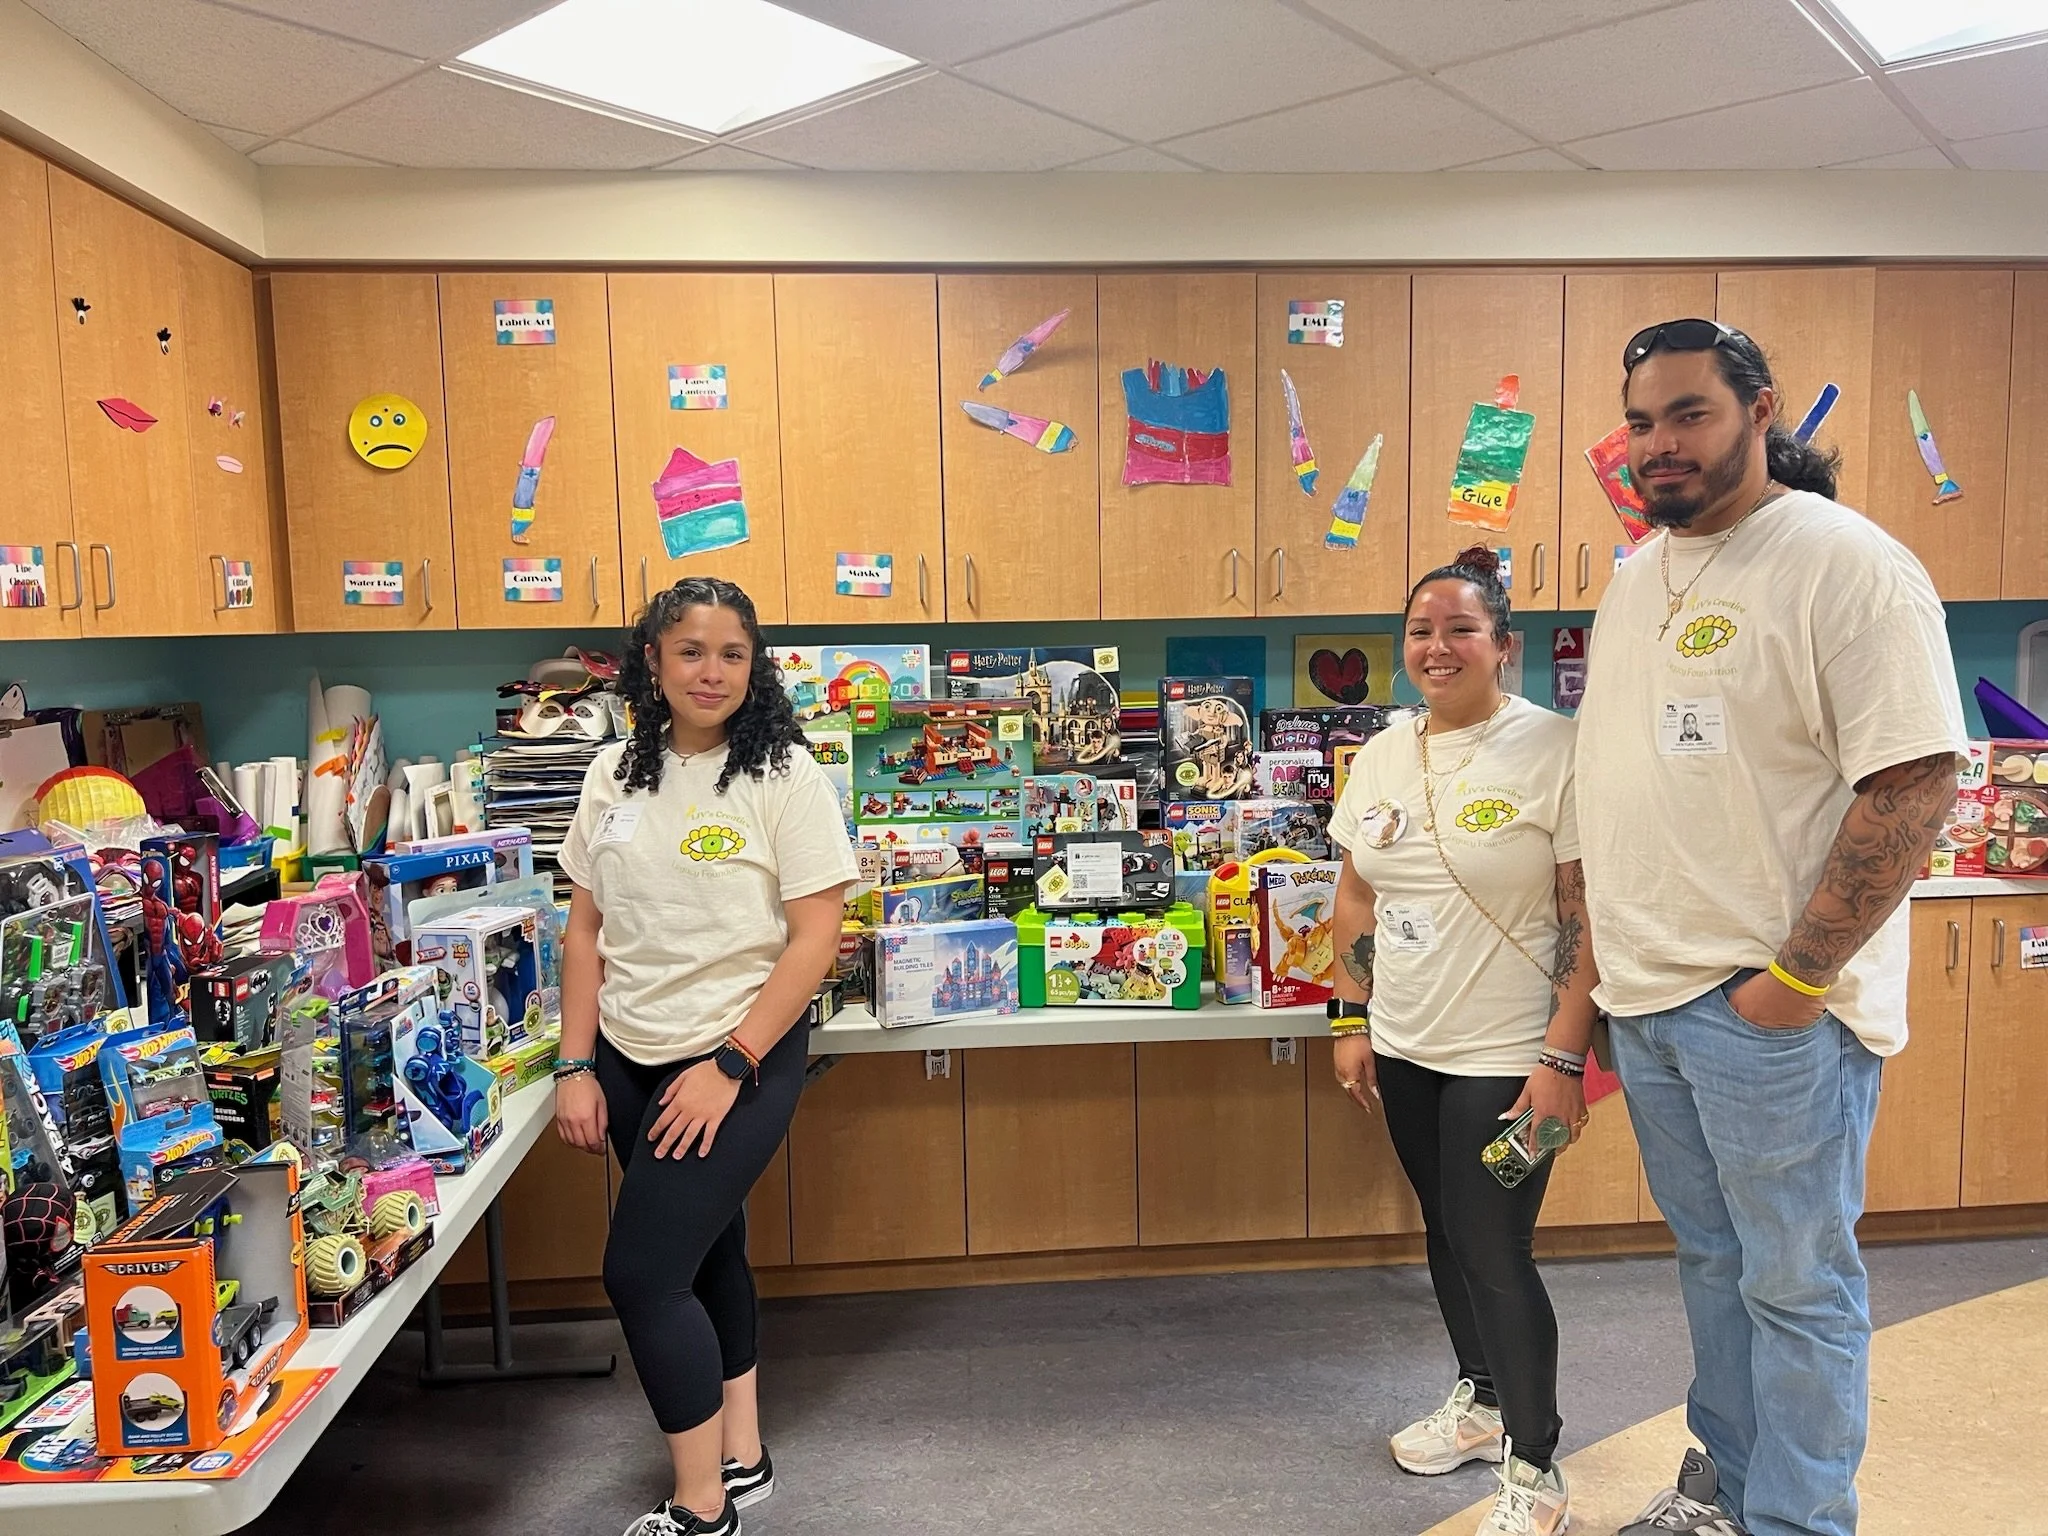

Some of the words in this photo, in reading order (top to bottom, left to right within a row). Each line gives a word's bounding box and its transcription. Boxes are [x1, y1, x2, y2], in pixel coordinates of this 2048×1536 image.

[499, 318, 532, 327] Fabric
[534, 318, 551, 327] Art
[1461, 487, 1503, 508] Glue
[513, 574, 553, 583] Canvas
[849, 569, 880, 578] Masks
[349, 579, 375, 588] Water
[377, 579, 397, 589] Play
[1712, 598, 1746, 615] Creative
[783, 660, 813, 672] duplo
[973, 654, 997, 671] Harry
[997, 652, 1022, 667] Potter
[1187, 684, 1206, 697] Harry
[1206, 682, 1225, 694] Potter
[1275, 714, 1321, 732] Deluxe
[813, 741, 844, 752] UPER
[813, 749, 849, 766] ARIO
[1269, 758, 1315, 767] personalized
[1307, 773, 1330, 789] my
[1486, 784, 1523, 801] Creative
[1983, 787, 1995, 796] 41
[1187, 805, 1219, 815] SONIC
[715, 810, 752, 829] Creative
[987, 831, 1015, 839] MICKEY
[445, 850, 491, 867] PIXAR
[860, 857, 876, 867] 8+
[913, 852, 943, 865] MARVEL
[894, 870, 904, 878] 8+
[1268, 876, 1286, 885] MEGA
[451, 943, 470, 953] TOY
[1064, 939, 1090, 951] duplo
[893, 957, 921, 965] MAGNETIC
[893, 963, 918, 971] BUILDING
[919, 961, 934, 970] TILES
[1271, 984, 1282, 994] 8+
[157, 1029, 189, 1053] WHEELS
[209, 1089, 249, 1106] URTLES
[214, 1107, 237, 1116] SEWER
[182, 1132, 212, 1157] WHEELS
[117, 1262, 169, 1275] DRIVEN
[254, 1354, 280, 1386] DRIVEN
